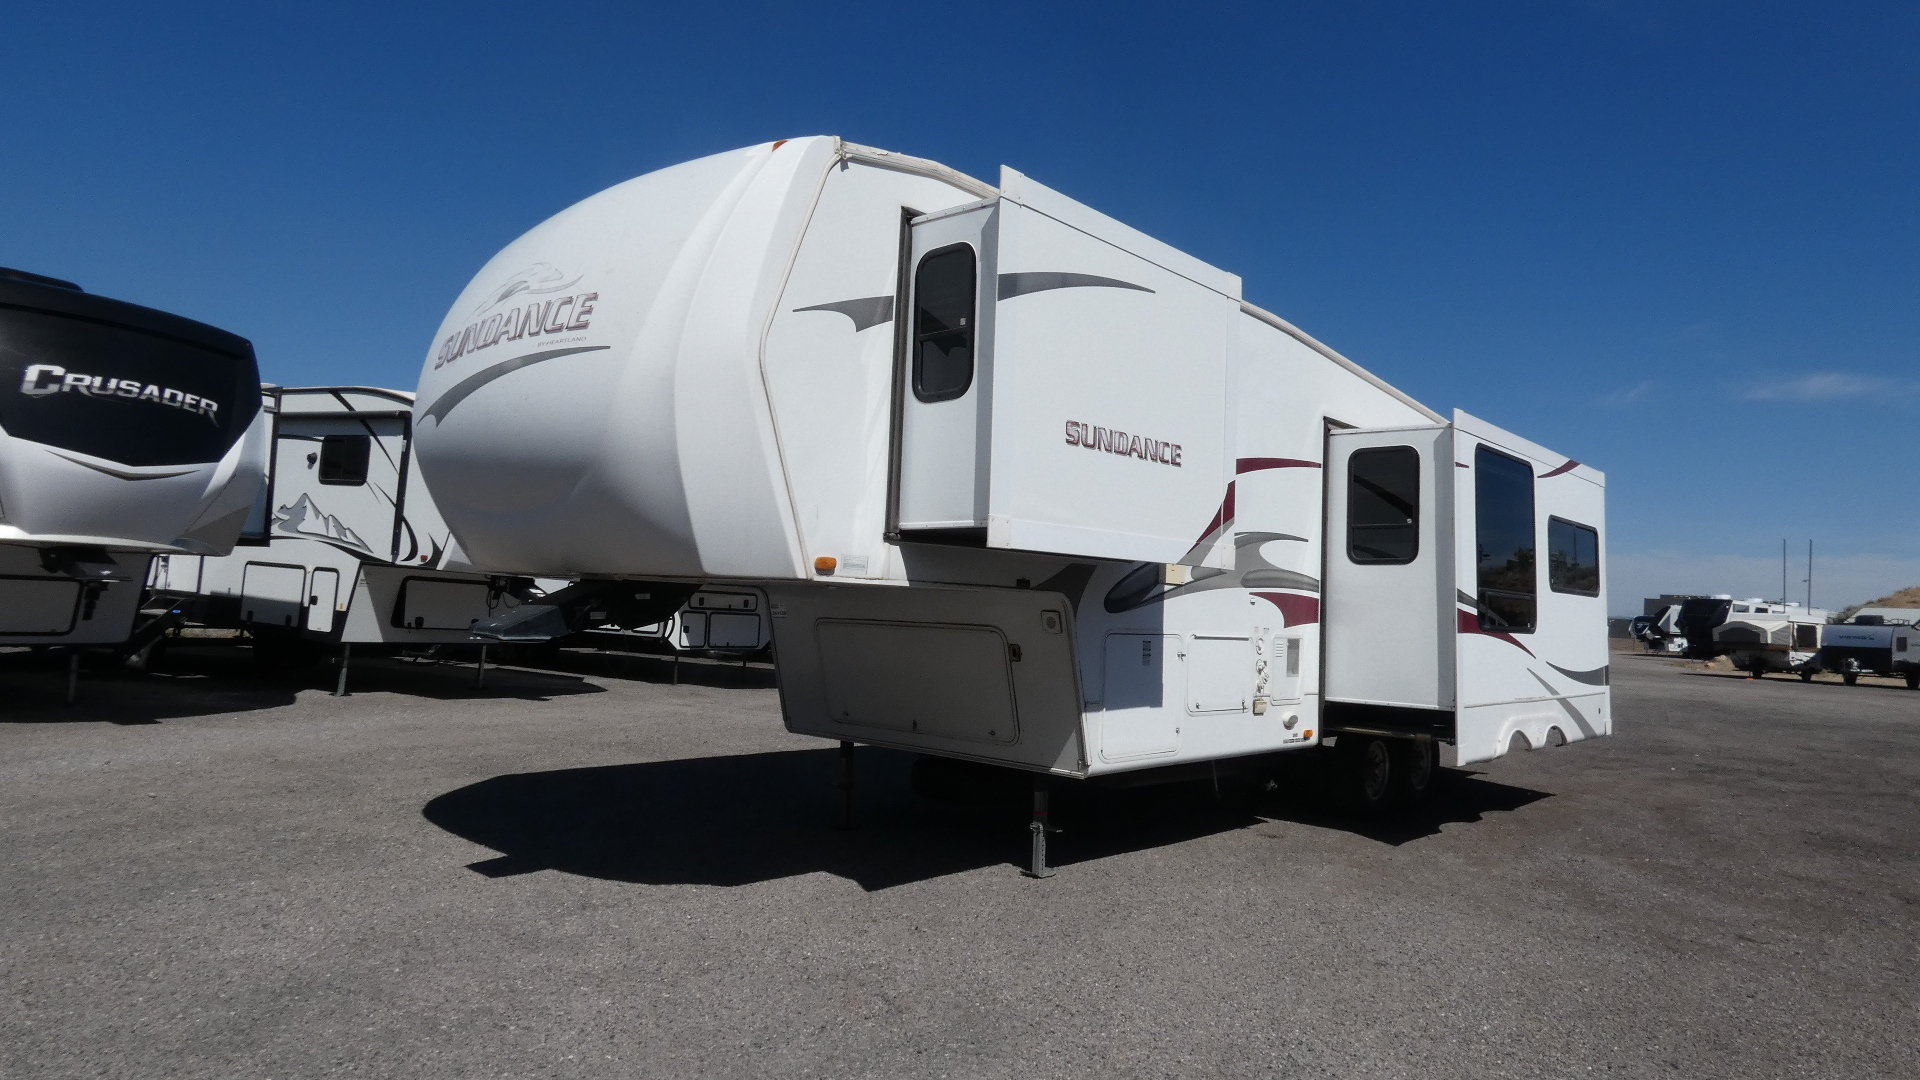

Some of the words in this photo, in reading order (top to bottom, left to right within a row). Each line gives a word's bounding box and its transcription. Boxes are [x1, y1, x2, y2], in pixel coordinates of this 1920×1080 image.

[434, 292, 599, 371] SUNDANCE
[20, 364, 219, 427] CRUSADER
[1065, 419, 1182, 468] SUNDANCE
